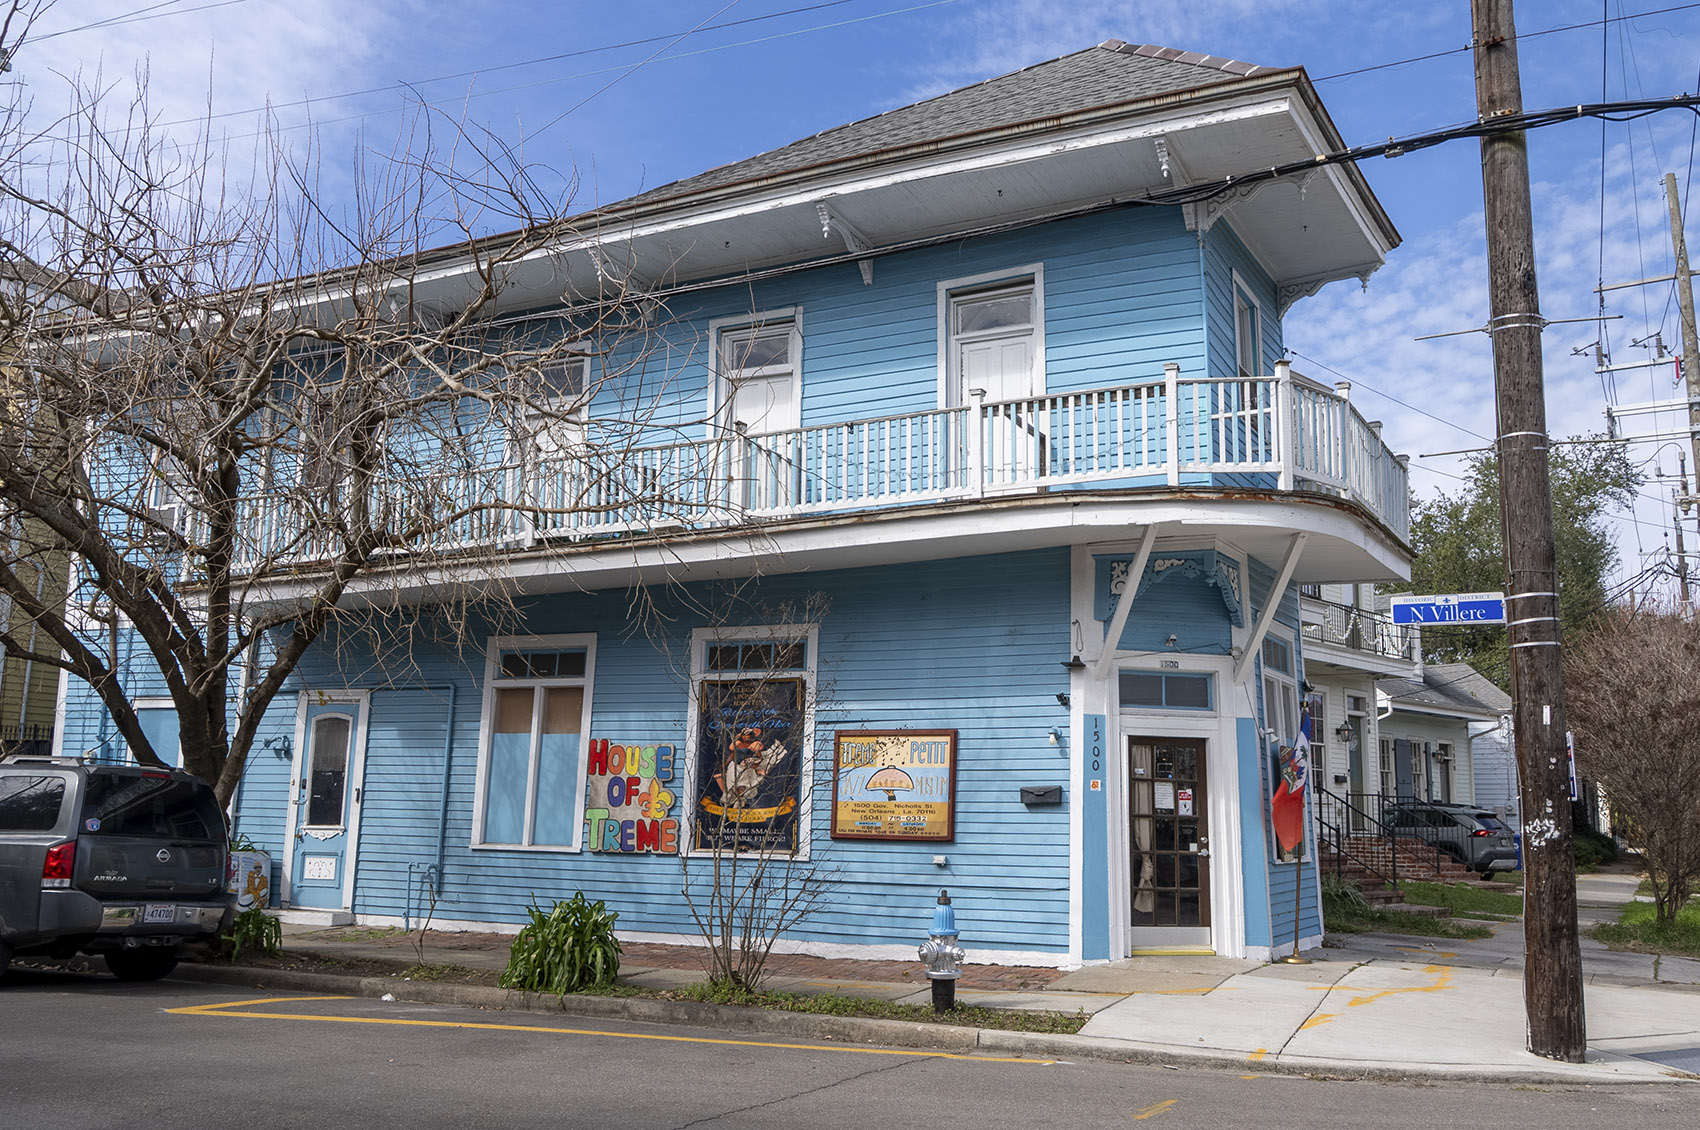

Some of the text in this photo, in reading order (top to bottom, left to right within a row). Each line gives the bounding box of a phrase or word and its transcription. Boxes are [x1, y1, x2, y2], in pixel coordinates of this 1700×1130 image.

[1410, 604, 1486, 622] N Villere
[589, 739, 672, 779] HOUSE
[1092, 717, 1100, 771] 1500
[607, 776, 641, 807] OF
[586, 808, 677, 852] TREME
[150, 909, 173, 919] 474700
